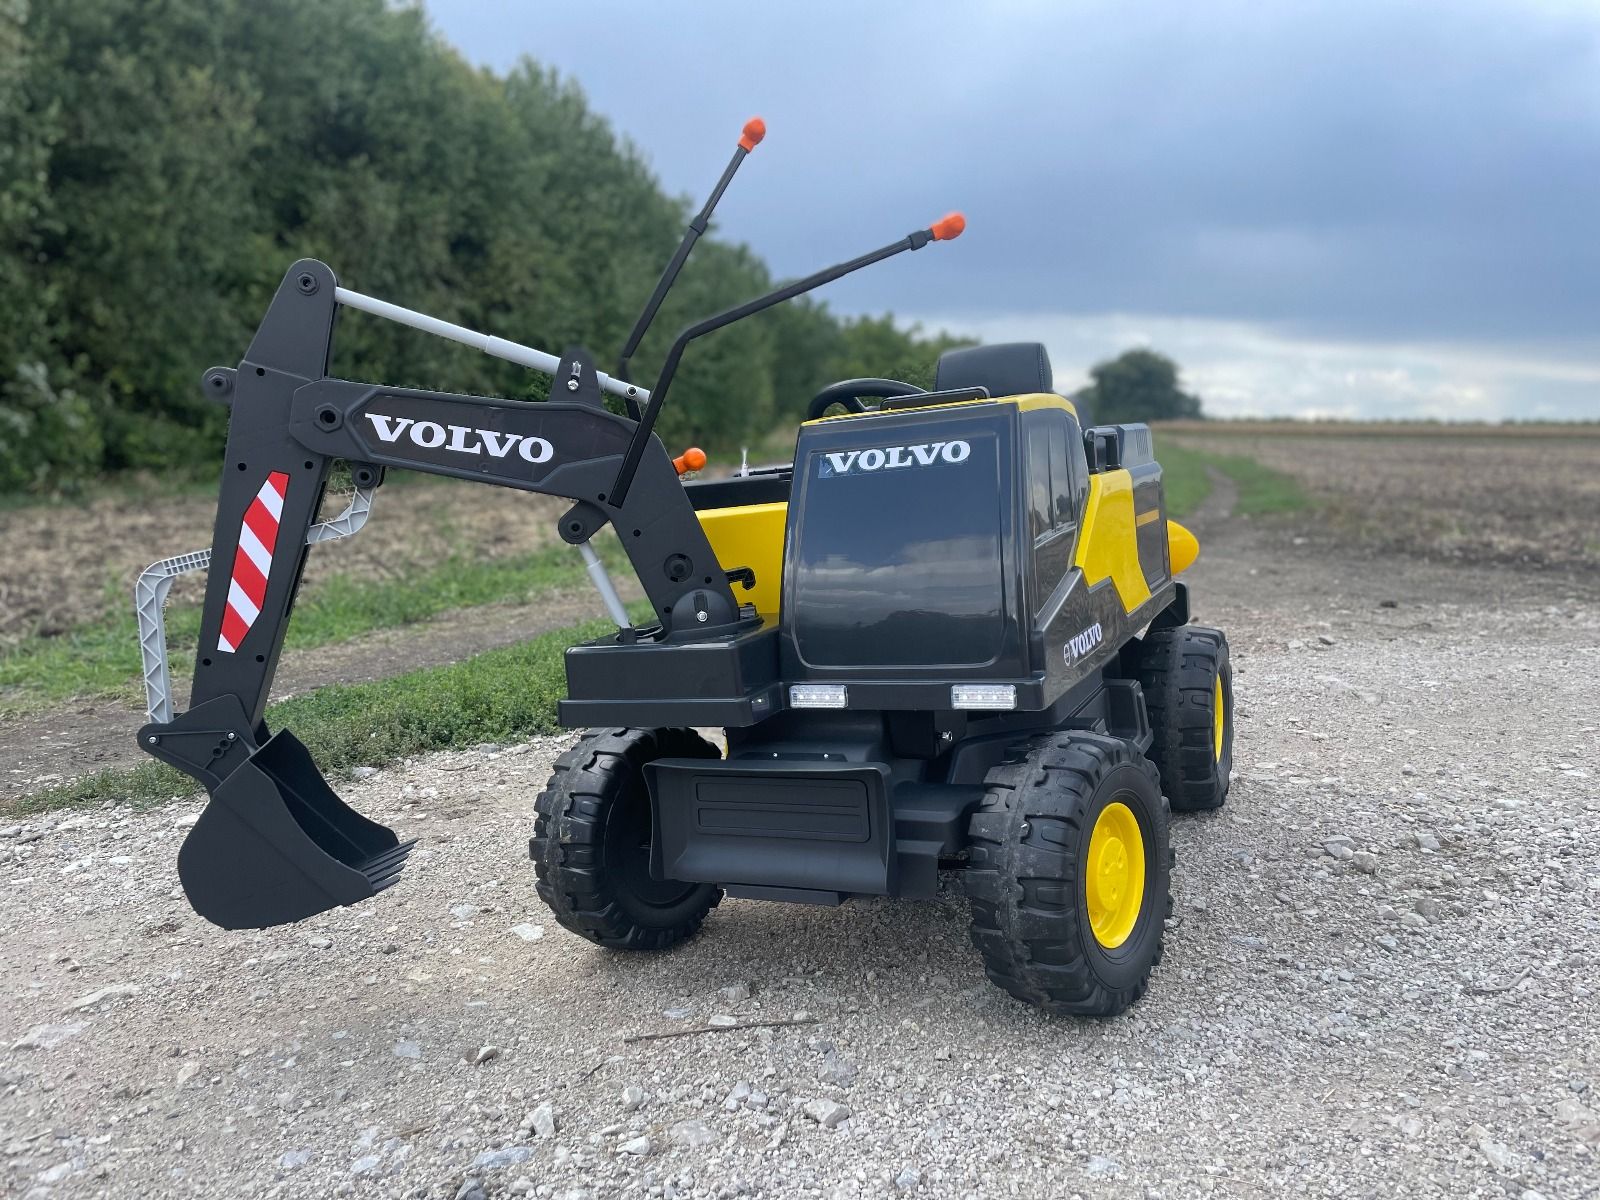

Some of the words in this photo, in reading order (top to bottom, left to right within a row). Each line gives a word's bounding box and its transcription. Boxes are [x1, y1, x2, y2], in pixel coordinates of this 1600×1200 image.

[365, 412, 554, 464] VOLVO
[826, 440, 971, 473] VOLVO
[1069, 622, 1102, 658] VOLVO
